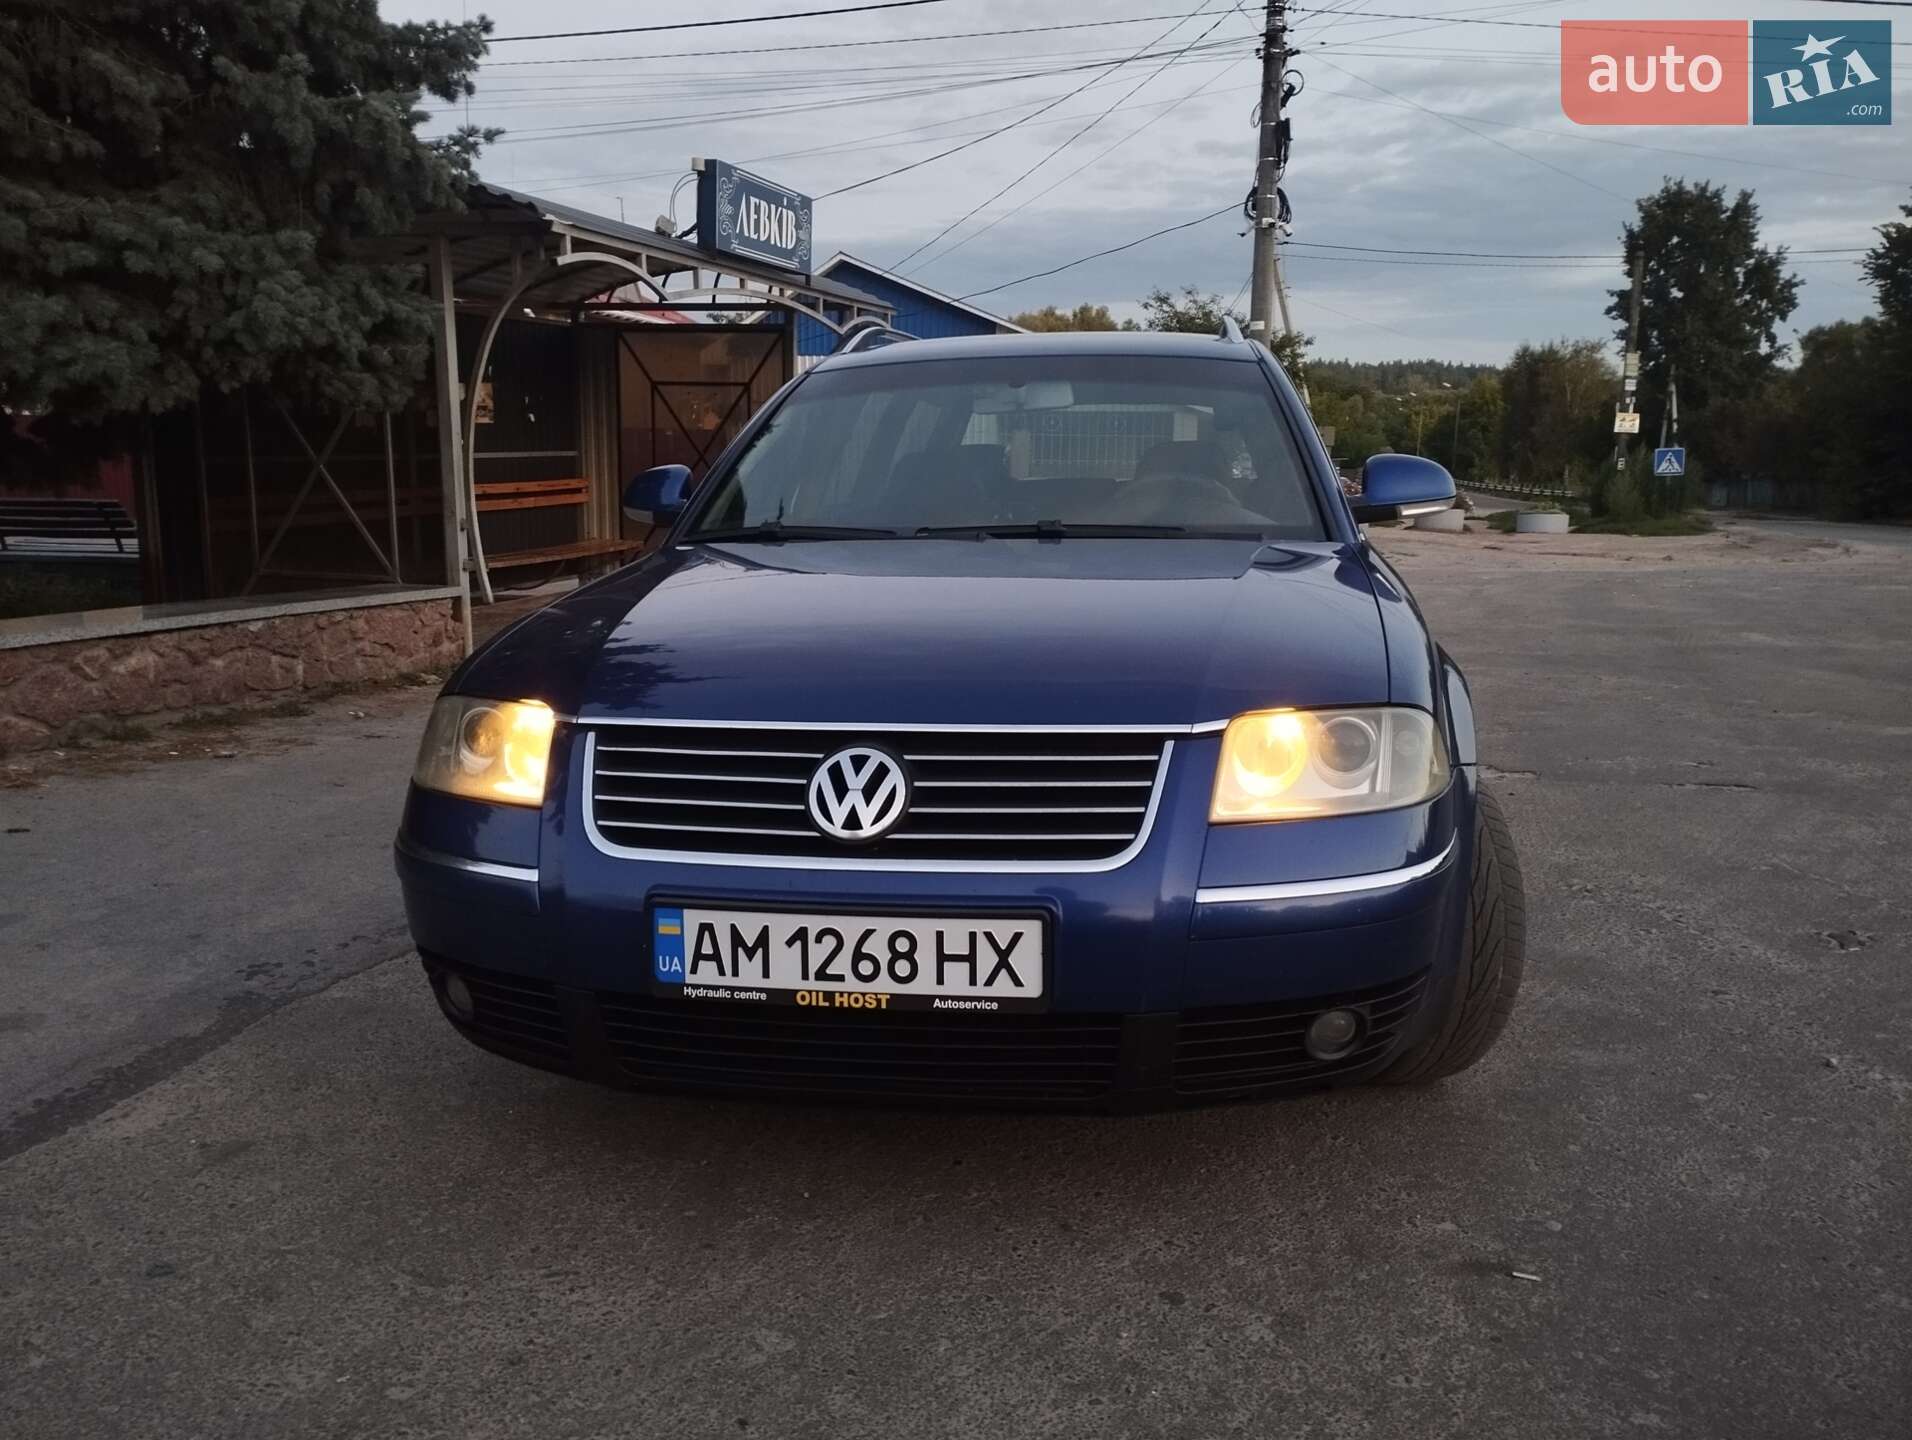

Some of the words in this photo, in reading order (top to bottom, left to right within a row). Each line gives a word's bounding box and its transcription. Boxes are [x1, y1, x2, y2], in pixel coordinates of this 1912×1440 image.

[735, 191, 796, 250] ЛЕВКІВ
[689, 921, 770, 979] AM
[784, 926, 918, 984] 1268
[935, 930, 1024, 988] HX
[658, 956, 682, 974] UA
[683, 986, 731, 1000] Hydraulic
[733, 989, 767, 1001] centre
[796, 991, 830, 1007] OIL
[834, 992, 890, 1009] HOST
[933, 998, 998, 1011] Autoservice
